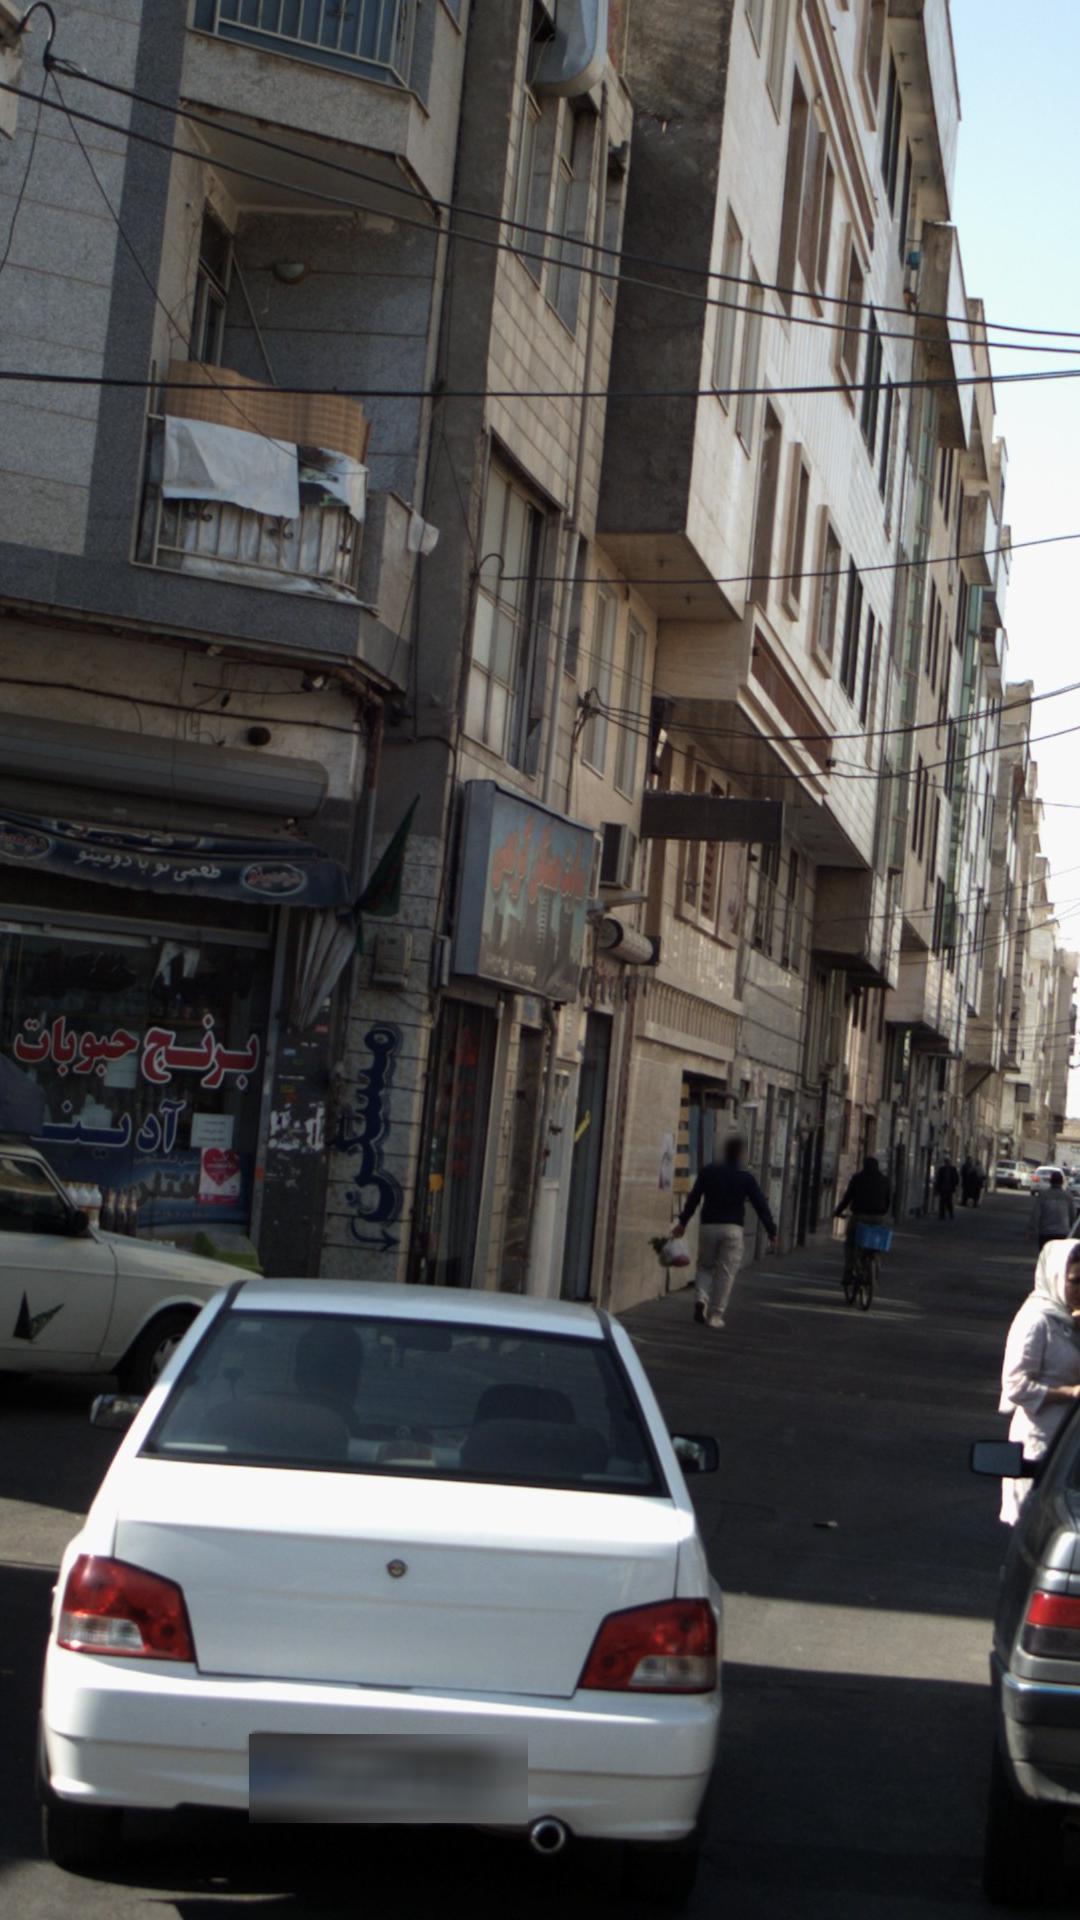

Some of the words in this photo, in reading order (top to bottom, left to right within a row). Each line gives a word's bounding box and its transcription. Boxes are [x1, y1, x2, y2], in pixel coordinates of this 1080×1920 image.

[13, 1016, 139, 1077] حبوبات
[141, 1013, 260, 1090] برنج
[30, 1098, 186, 1159] آدین
